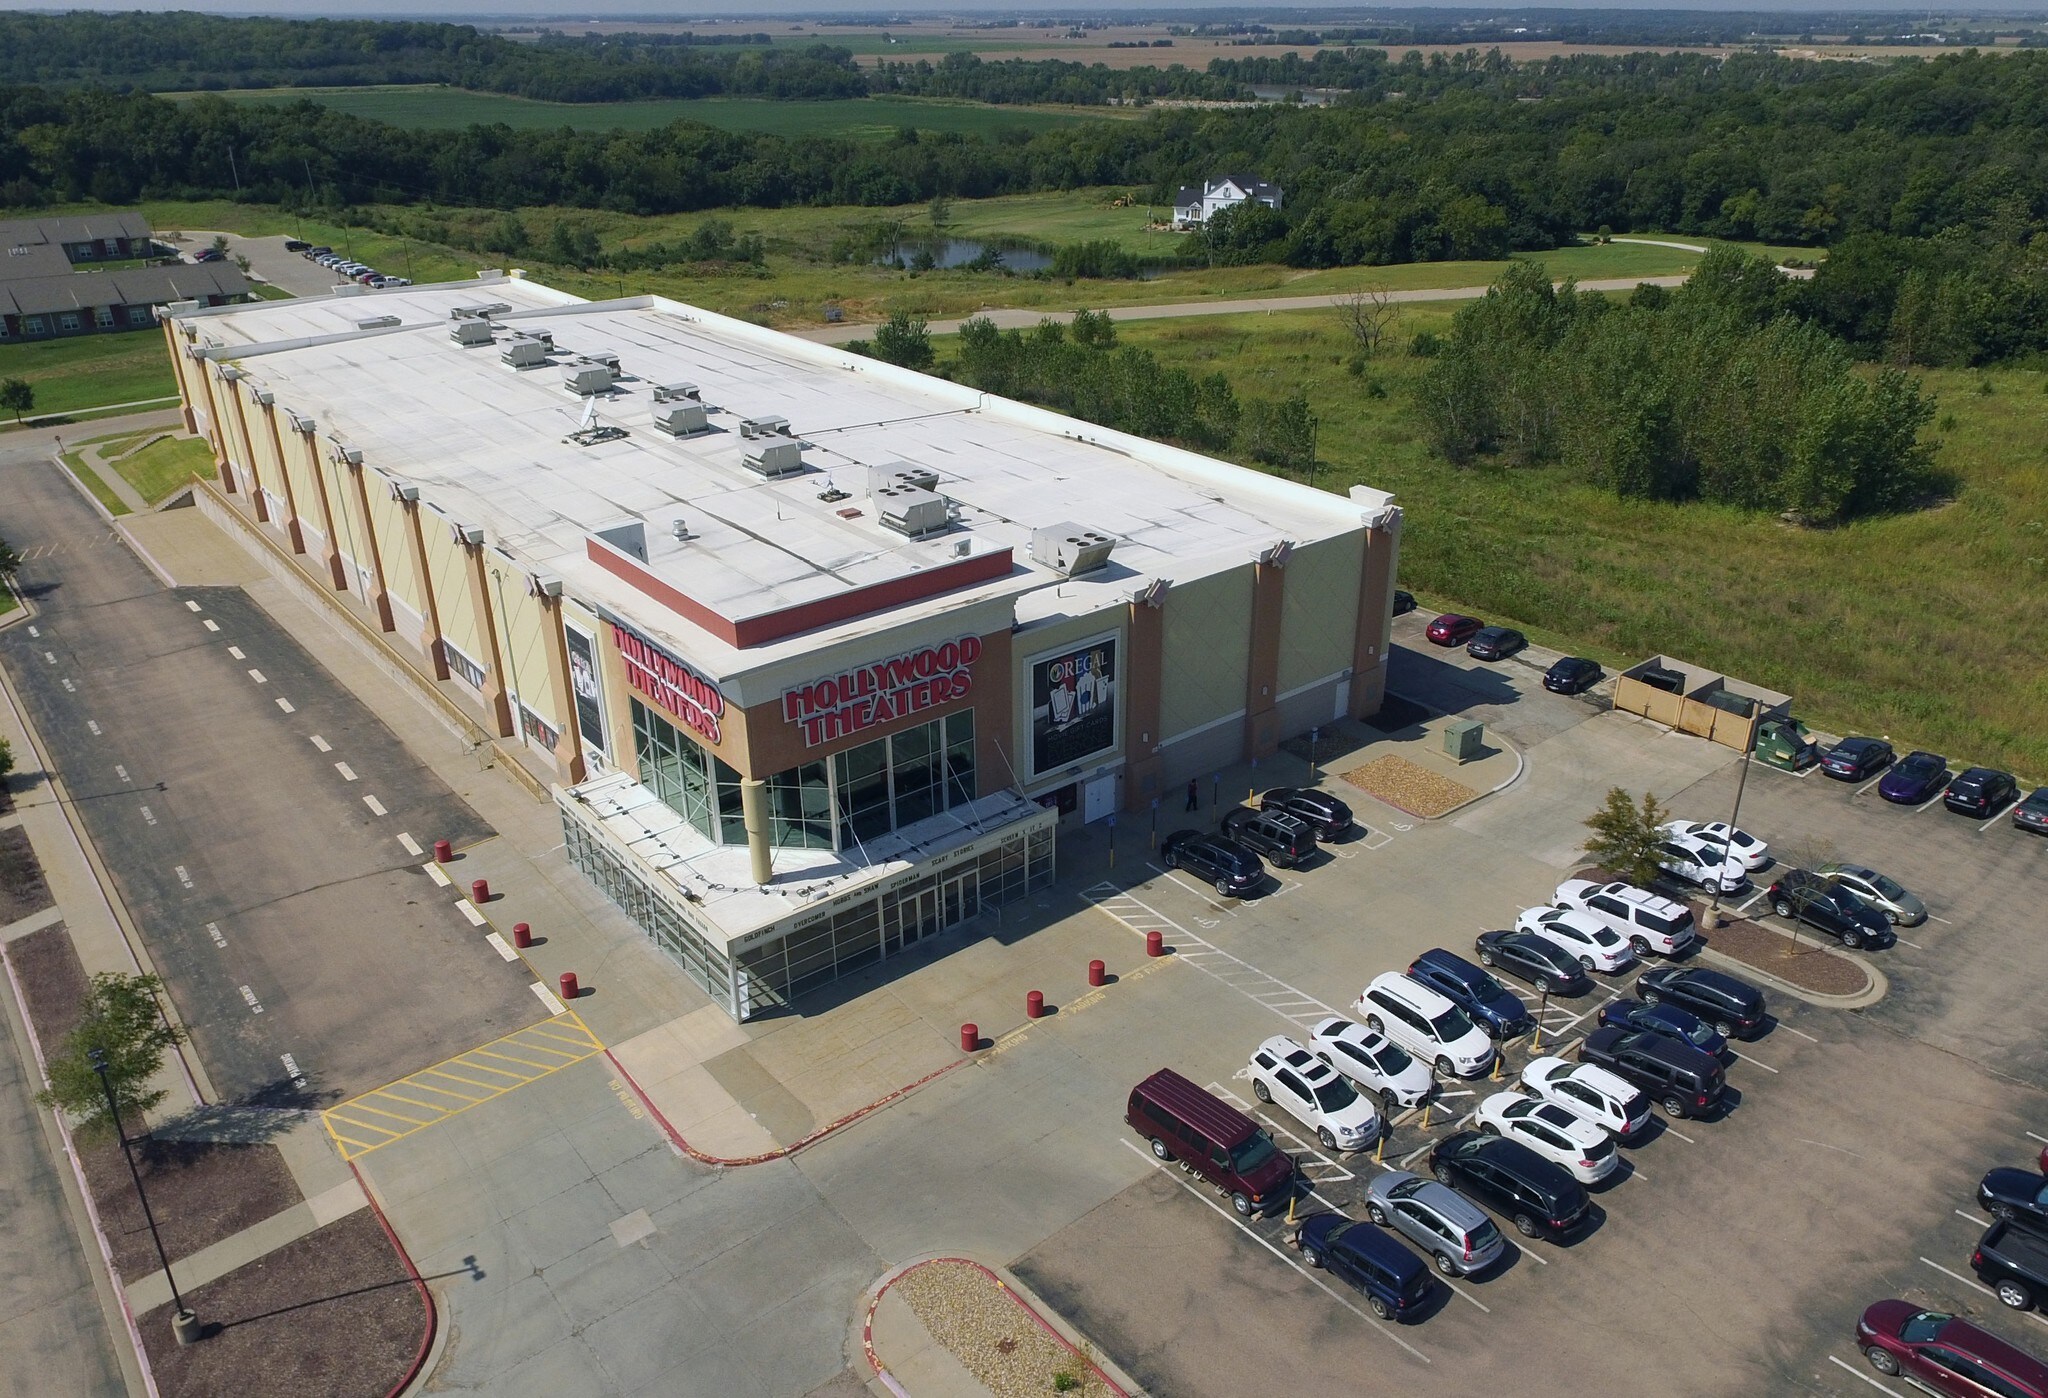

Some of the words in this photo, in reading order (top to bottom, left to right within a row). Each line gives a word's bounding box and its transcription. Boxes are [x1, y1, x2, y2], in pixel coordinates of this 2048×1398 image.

[611, 624, 722, 716] HOLLYWOOD
[624, 660, 719, 742] THEATERS
[784, 635, 983, 722] HOLLYWOOD
[1064, 651, 1107, 678] REGAL
[802, 669, 972, 746] THEATERS
[744, 925, 775, 943] GOLDFINCH
[793, 911, 826, 929] OVERCOMER
[864, 883, 879, 894] SHAW
[890, 872, 920, 890] SPIDERMAN
[280, 1052, 302, 1079] PARKING
